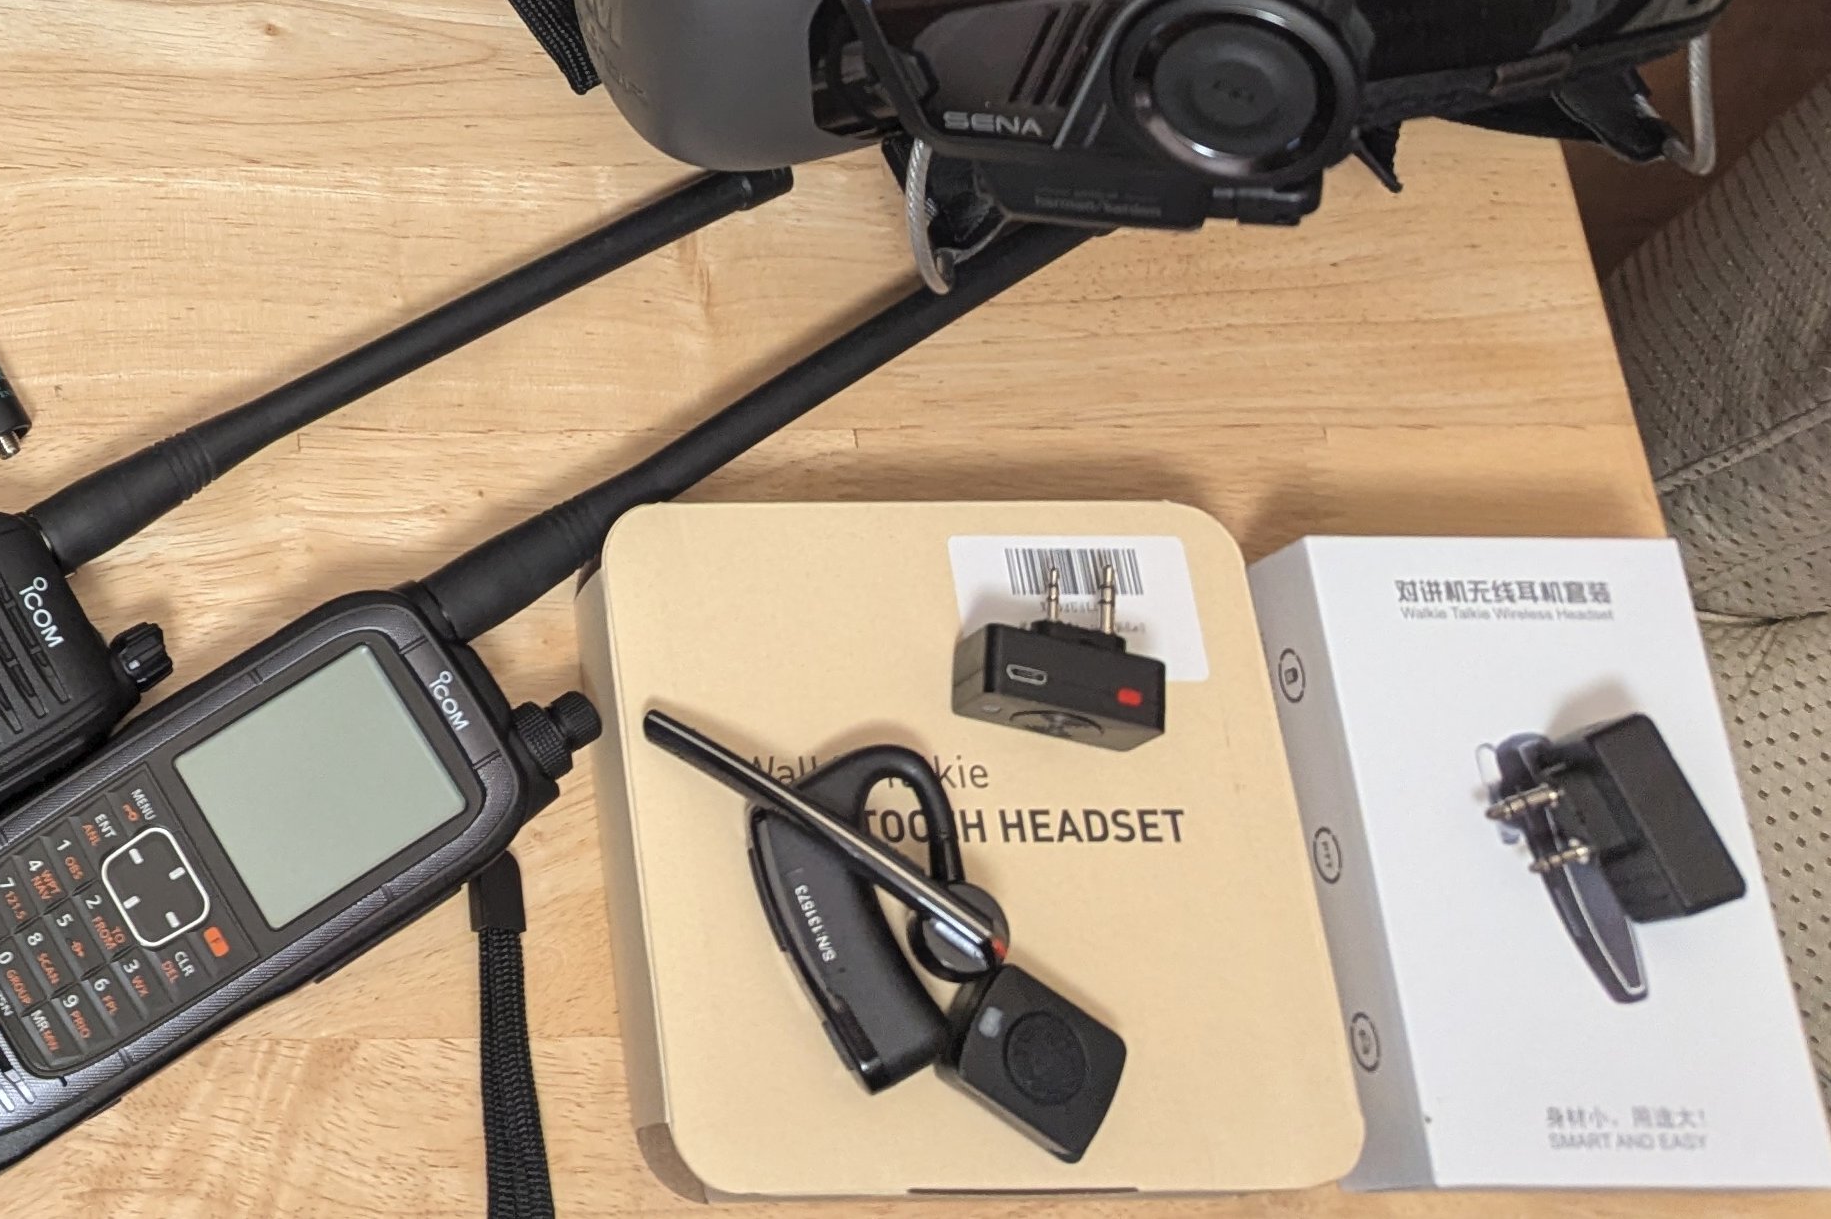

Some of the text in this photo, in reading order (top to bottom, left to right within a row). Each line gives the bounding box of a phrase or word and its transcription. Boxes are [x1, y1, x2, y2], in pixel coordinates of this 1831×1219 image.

[943, 111, 1043, 137] SENA
[131, 788, 156, 821] MENU
[1000, 809, 1185, 844] HEADSET
[57, 839, 72, 851] 1
[28, 860, 44, 871] 4
[65, 856, 84, 880] OBS
[30, 875, 52, 902] NAV
[94, 813, 194, 977] ENT CLR
[85, 895, 102, 909] 2
[56, 913, 73, 927] 5
[93, 916, 118, 950] FROM
[5, 890, 26, 921] 121.5
[27, 932, 43, 946] 8
[37, 951, 60, 985] SCAN
[62, 995, 79, 1008] 9
[122, 959, 140, 973] 3
[94, 978, 110, 992] 6
[132, 976, 149, 997] WX
[6, 969, 33, 1005] GROUP
[31, 1010, 49, 1031] MR
